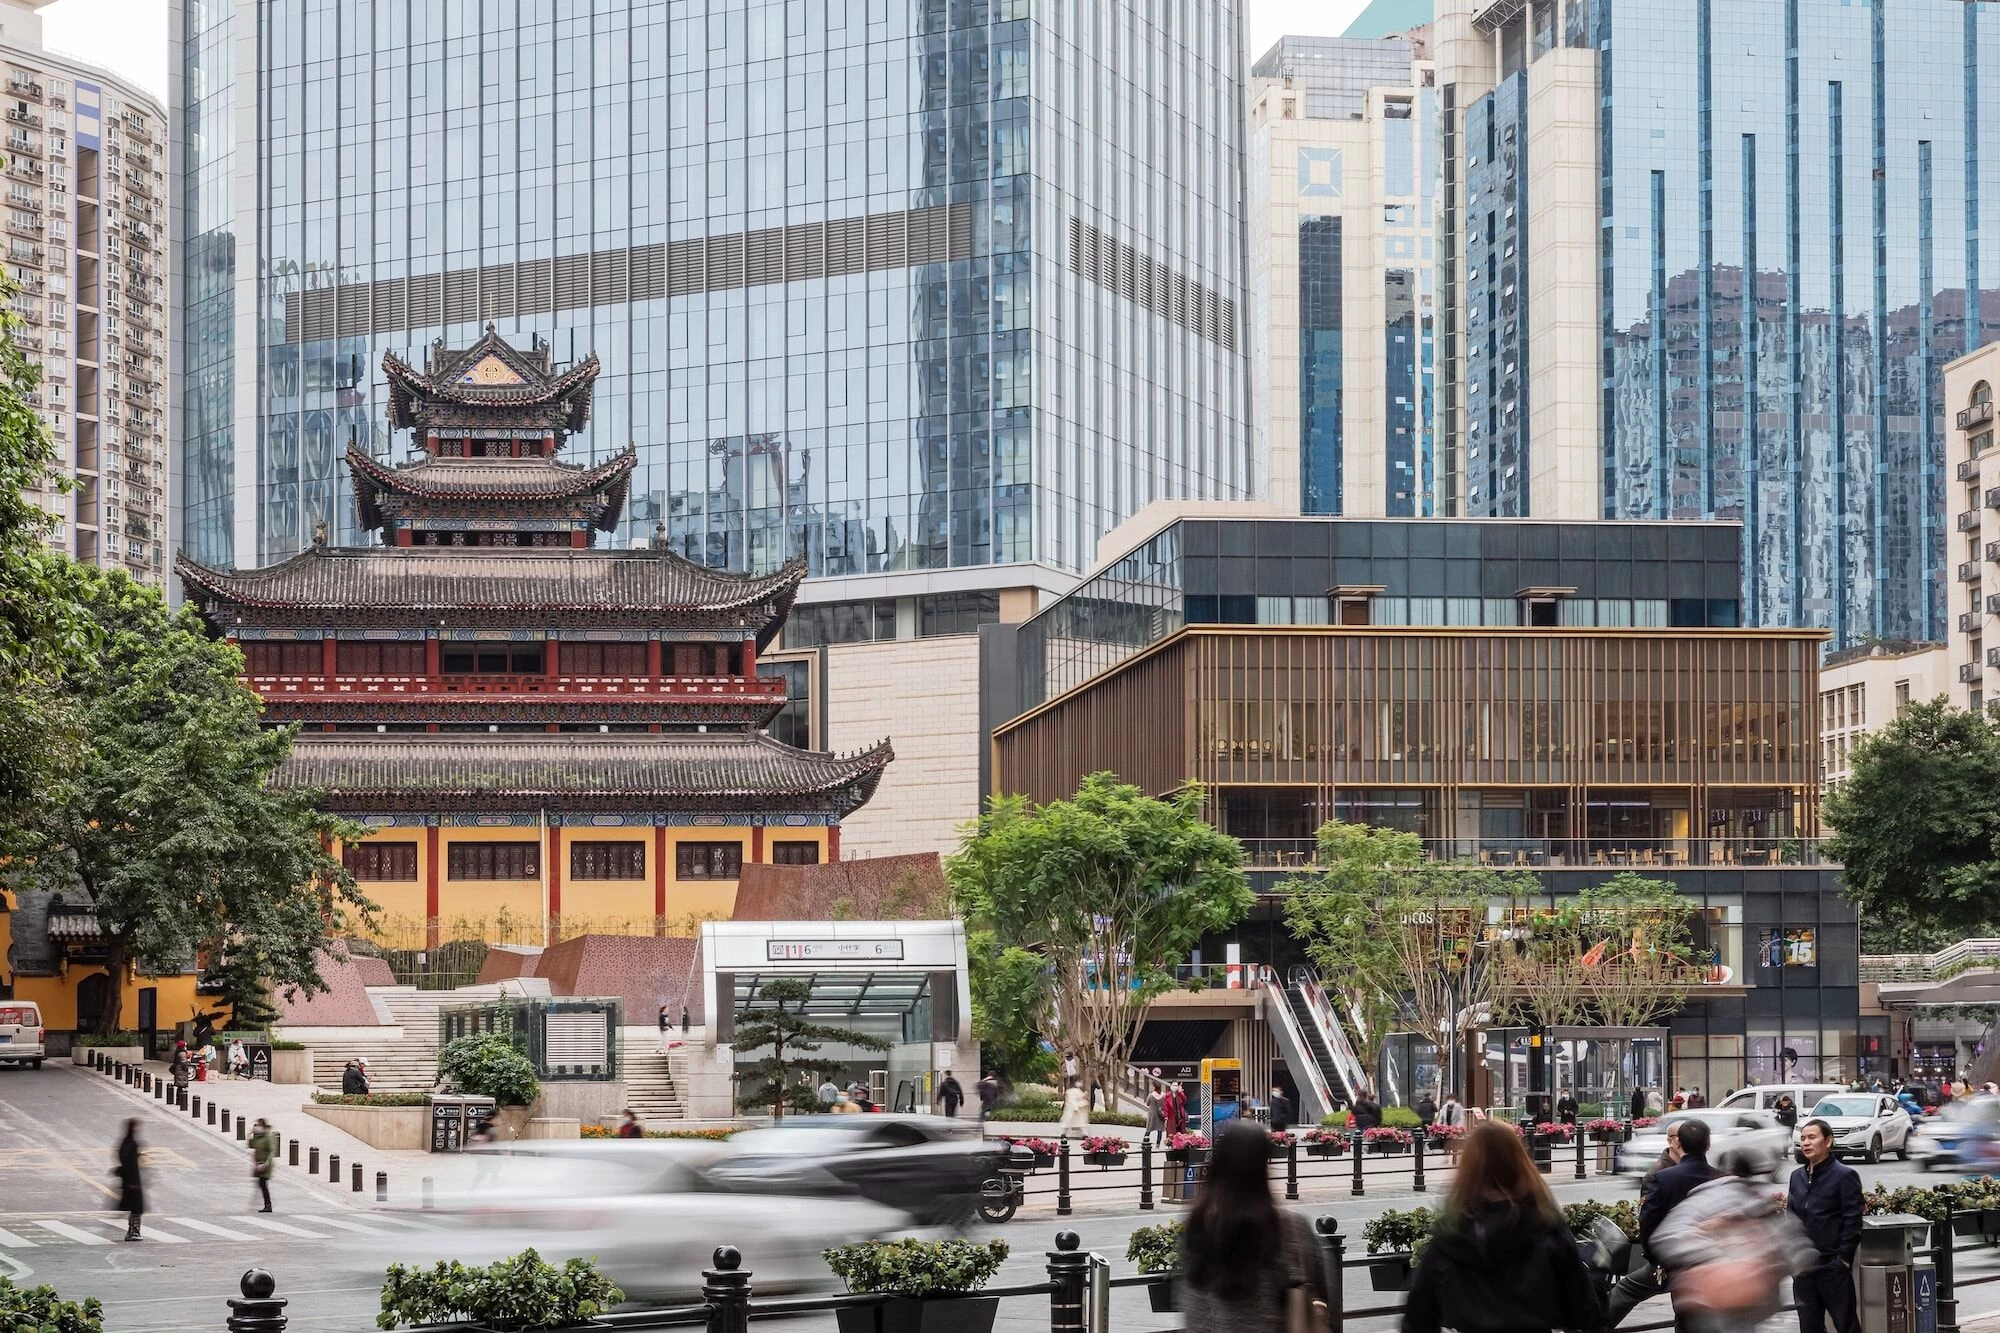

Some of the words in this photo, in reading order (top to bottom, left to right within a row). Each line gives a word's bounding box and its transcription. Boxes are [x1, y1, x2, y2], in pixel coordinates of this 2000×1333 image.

[791, 944, 797, 955] 1
[804, 944, 812, 955] 6
[875, 944, 883, 955] 6
[1790, 942, 1812, 963] 15
[1477, 1032, 1488, 1054] P
